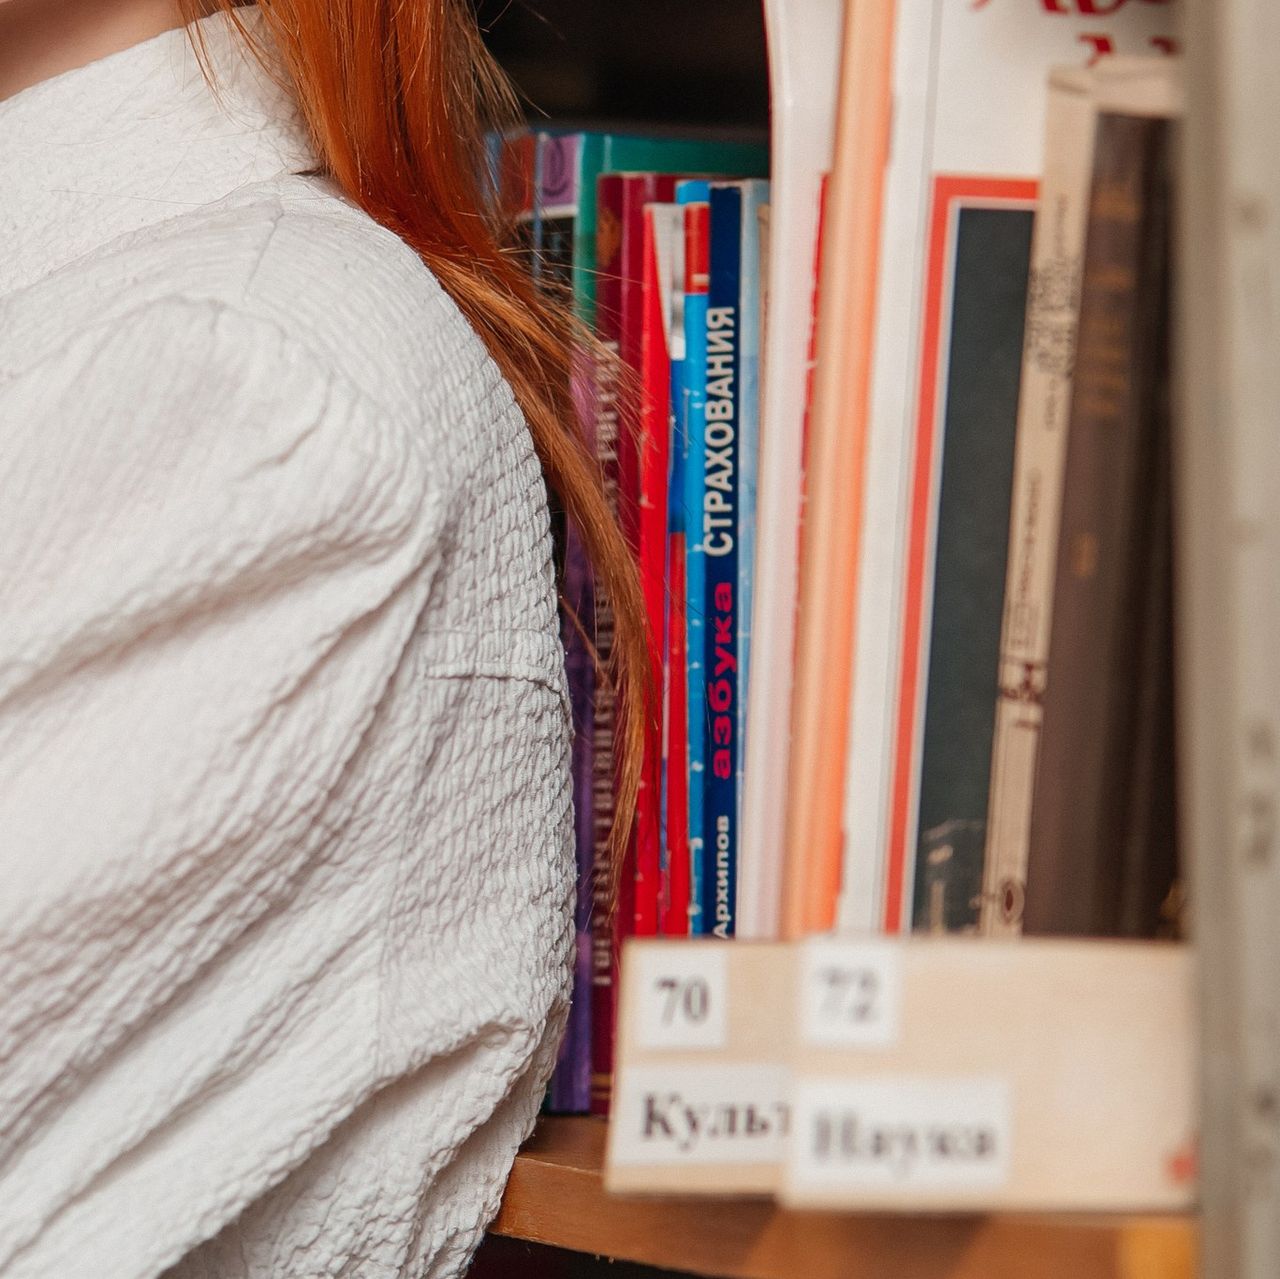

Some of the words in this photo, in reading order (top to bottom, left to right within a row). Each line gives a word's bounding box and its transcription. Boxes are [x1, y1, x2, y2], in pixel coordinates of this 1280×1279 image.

[703, 306, 735, 557] СТРАХОВАНИЯ
[708, 583, 738, 779] азбука
[712, 815, 731, 939] Архипов
[653, 974, 712, 1026] 70
[816, 966, 880, 1024] 72
[811, 1106, 1000, 1180] Наука
